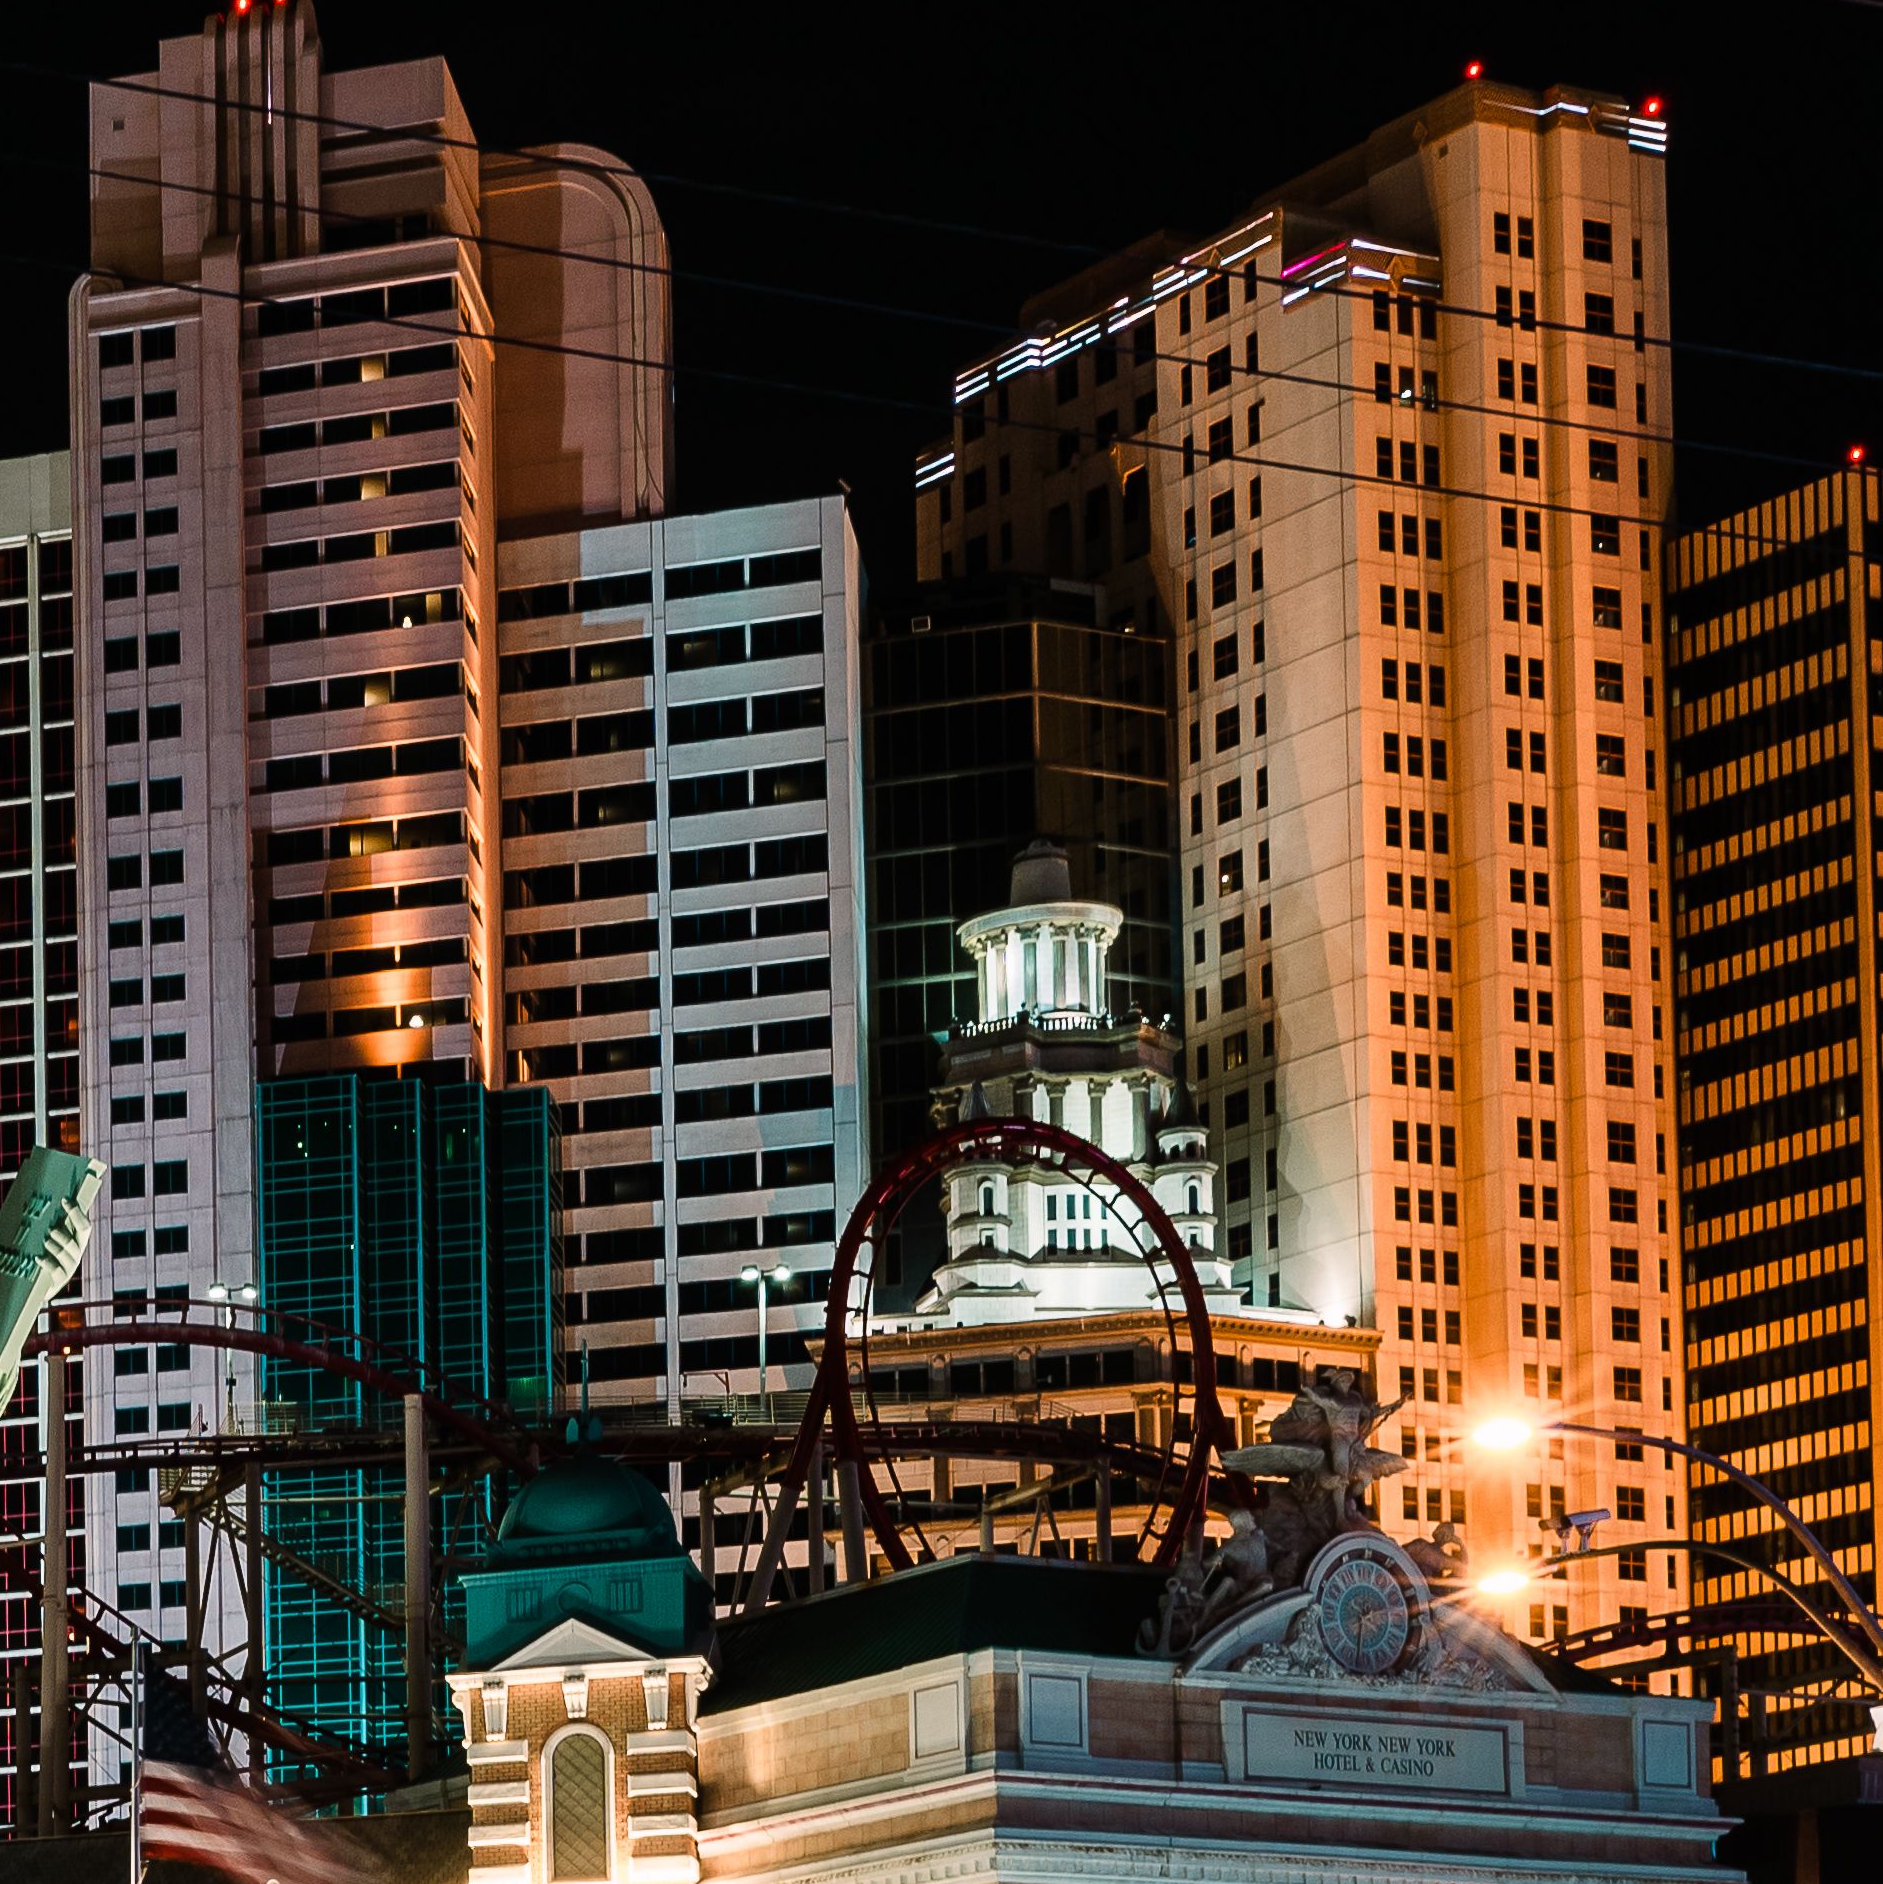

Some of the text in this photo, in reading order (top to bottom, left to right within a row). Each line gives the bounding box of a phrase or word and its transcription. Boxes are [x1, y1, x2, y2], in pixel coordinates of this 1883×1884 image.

[1293, 1729, 1456, 1758] NEW YORK NEW YORK
[1314, 1752, 1434, 1777] HOTEL & CASINO
